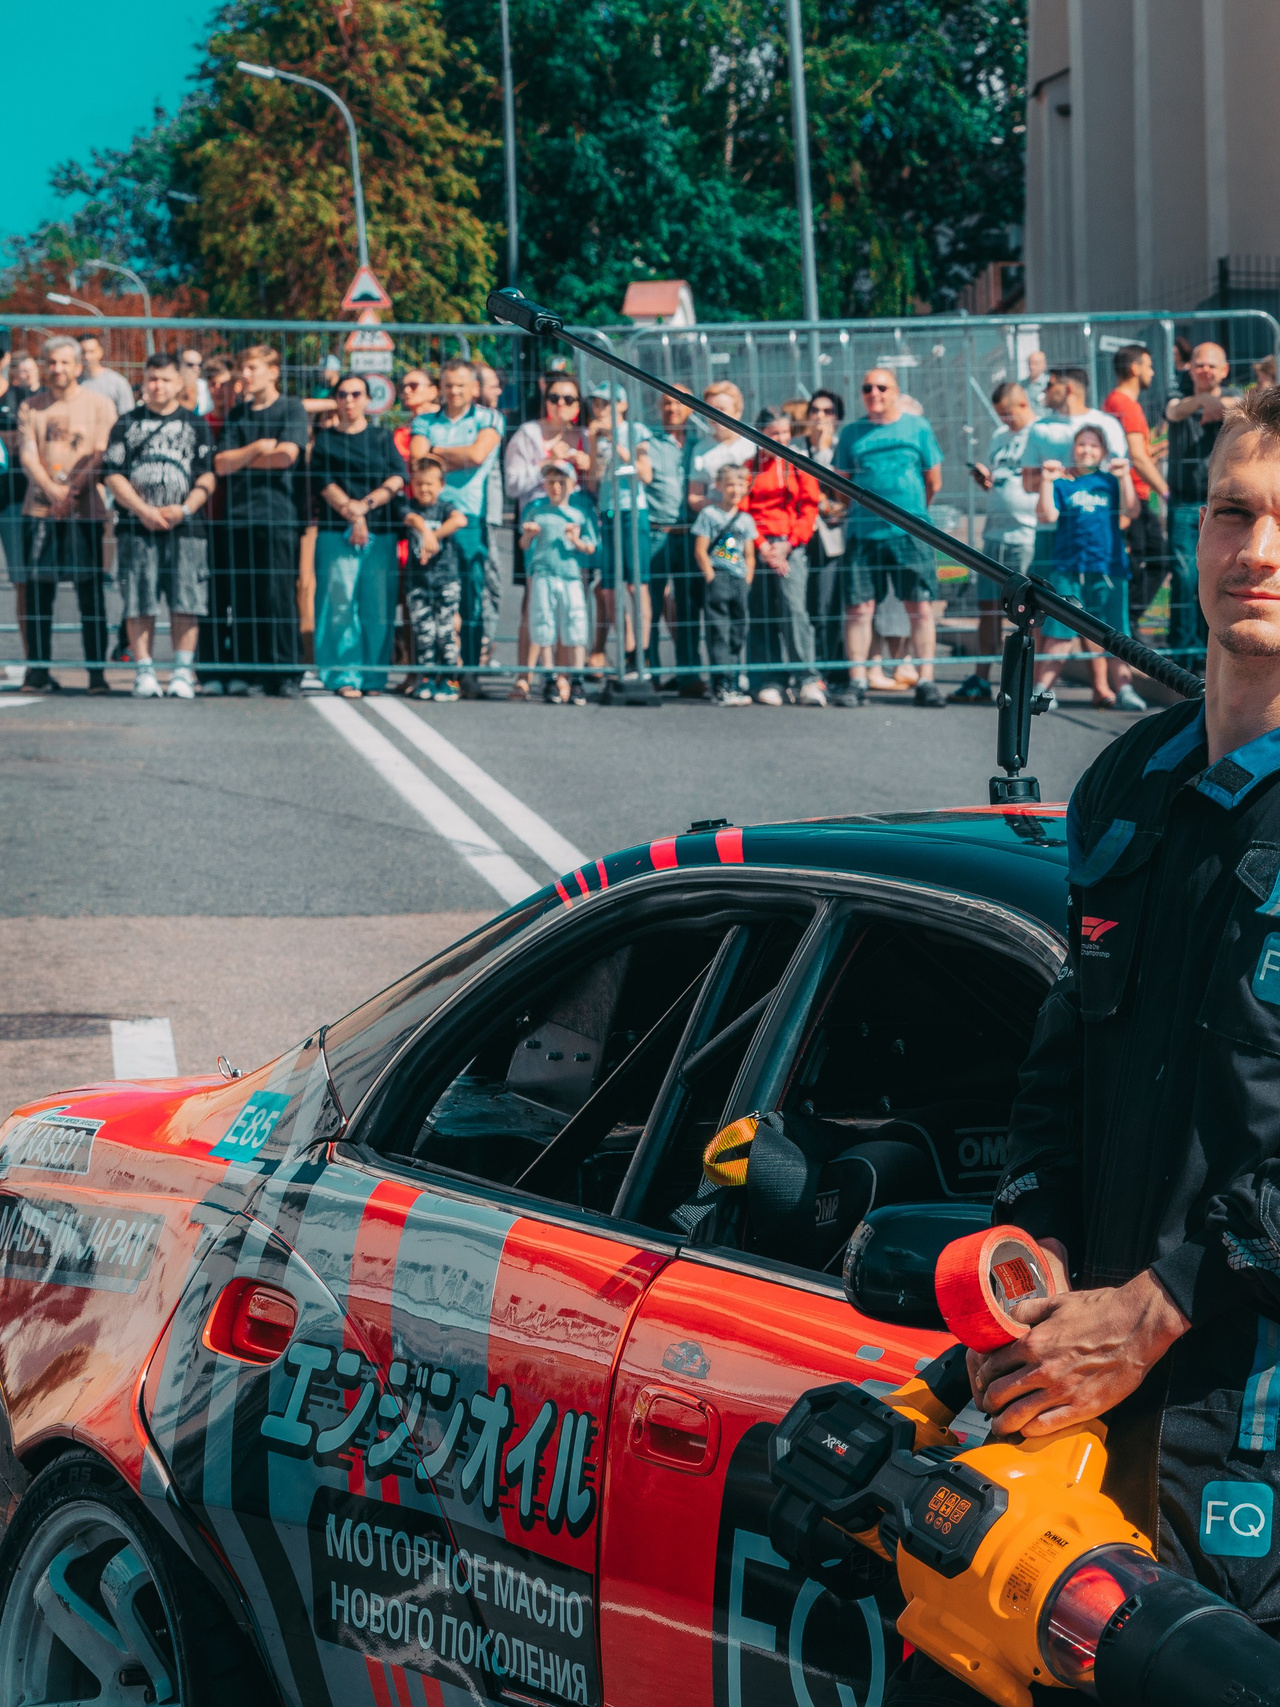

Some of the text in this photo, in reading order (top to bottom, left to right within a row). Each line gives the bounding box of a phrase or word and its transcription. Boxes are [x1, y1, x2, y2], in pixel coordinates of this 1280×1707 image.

[21, 1126, 87, 1165] KASCO
[223, 1105, 280, 1149] E85
[958, 1136, 1007, 1168] OM
[0, 1205, 156, 1267] MADE IN JAPAN
[260, 1342, 592, 1524] エンジンオイル
[1205, 1500, 1265, 1537] FQ
[325, 1513, 584, 1638] МОТОРНОЕ МАСЛО
[331, 1580, 588, 1705] НОВОГО ПОКОЛЕНИЯ
